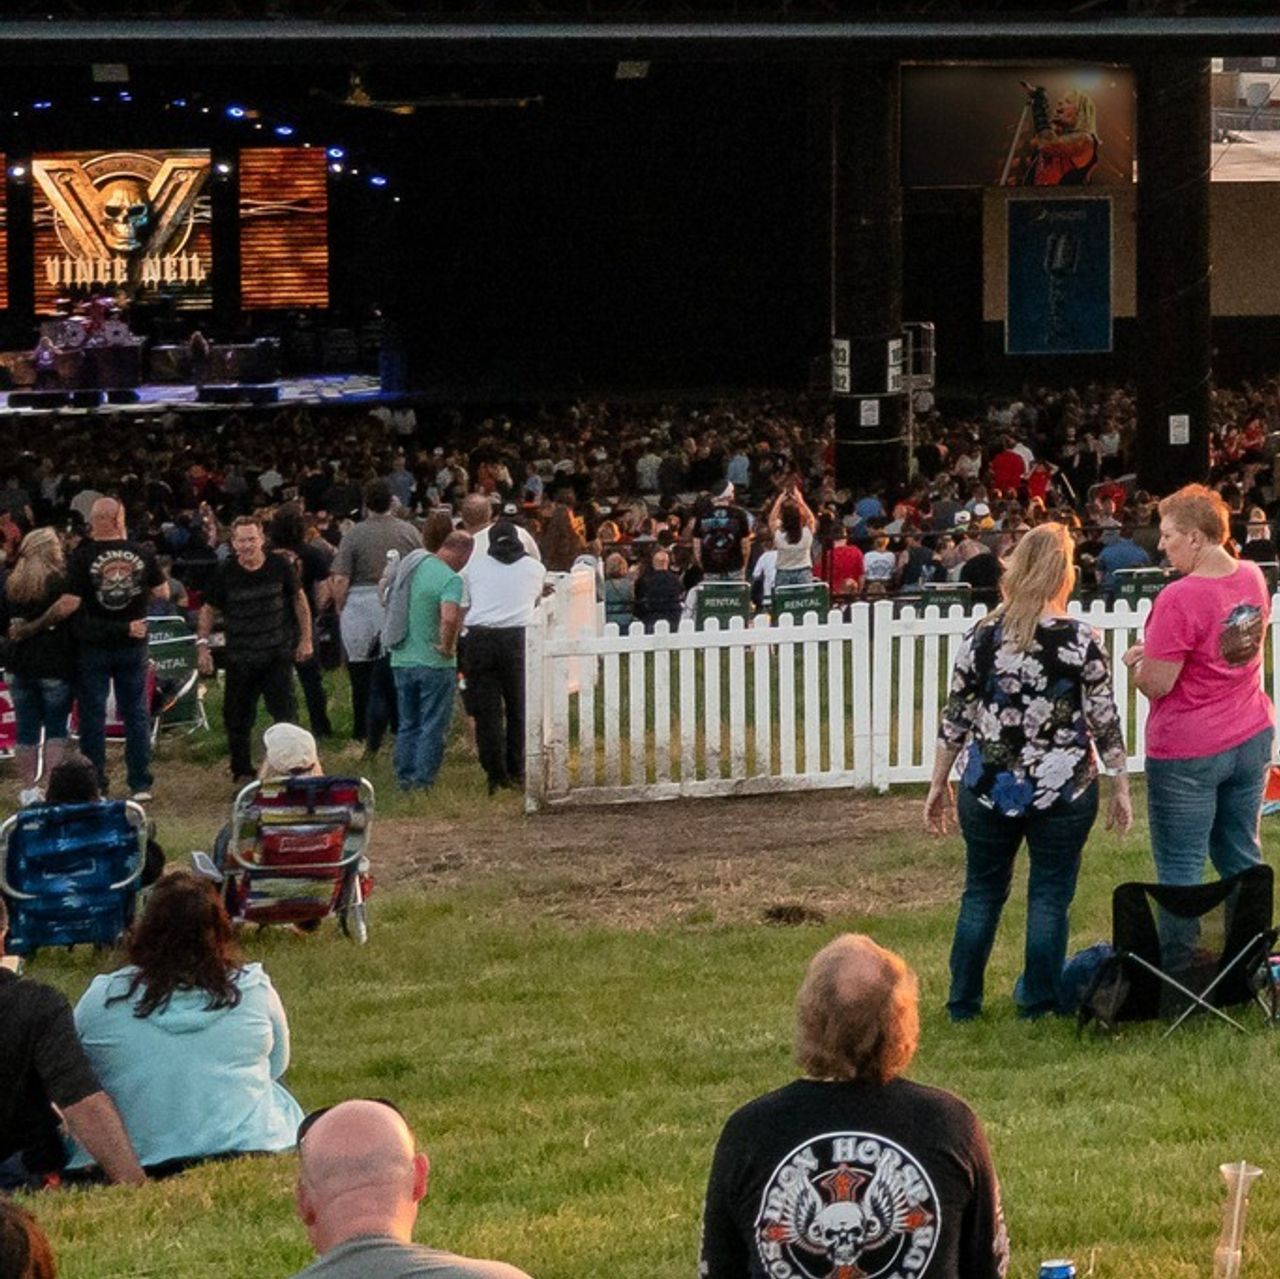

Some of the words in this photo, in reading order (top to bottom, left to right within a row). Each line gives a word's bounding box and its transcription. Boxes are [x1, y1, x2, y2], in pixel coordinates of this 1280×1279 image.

[44, 254, 128, 294] VINCE
[141, 249, 207, 291] NEIL
[704, 597, 741, 608] RENTAL
[784, 598, 821, 609] RENTAL
[156, 658, 188, 670] NTAL
[763, 1146, 819, 1221] IRON
[831, 1137, 931, 1207] HORSE
